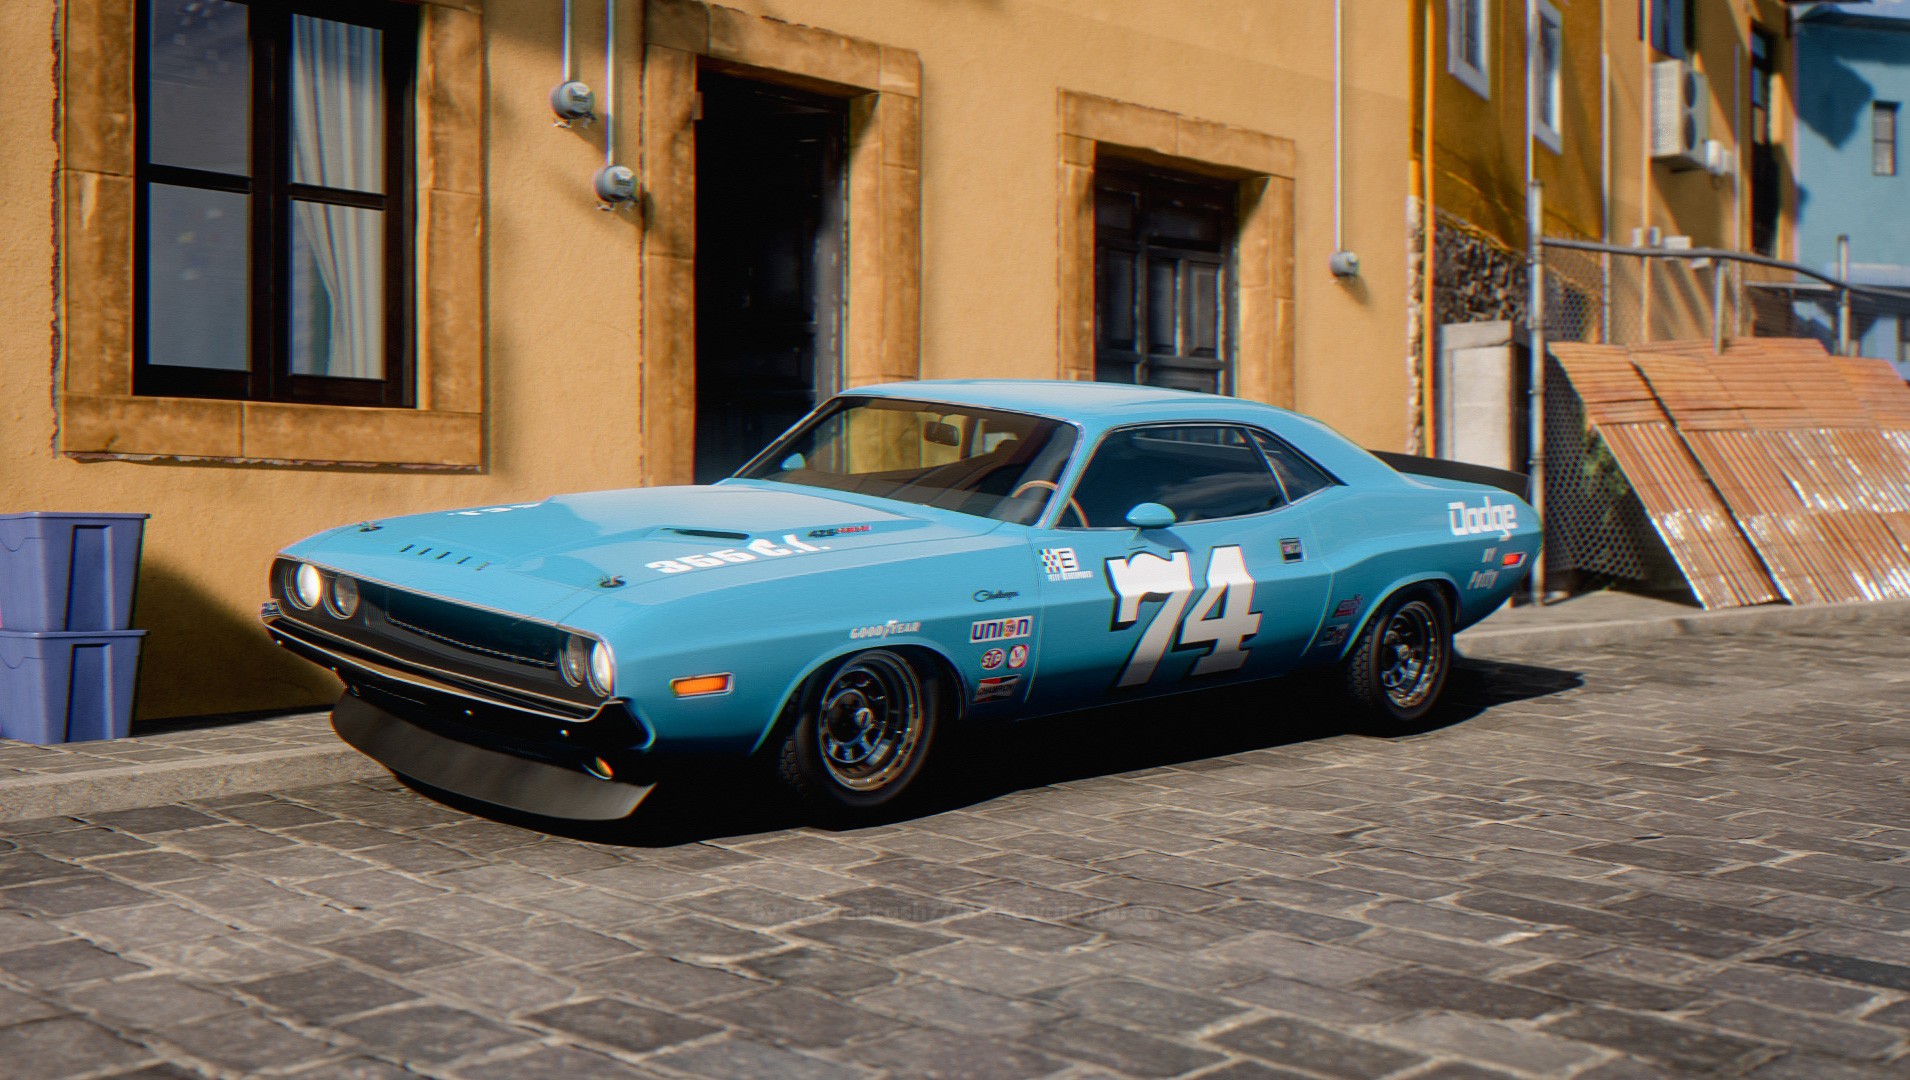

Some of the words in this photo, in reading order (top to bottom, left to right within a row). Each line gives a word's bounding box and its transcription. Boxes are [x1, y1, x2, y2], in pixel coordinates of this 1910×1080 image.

[1448, 496, 1518, 541] Dodge
[1104, 543, 1262, 688] 74
[982, 650, 1002, 667] STP
